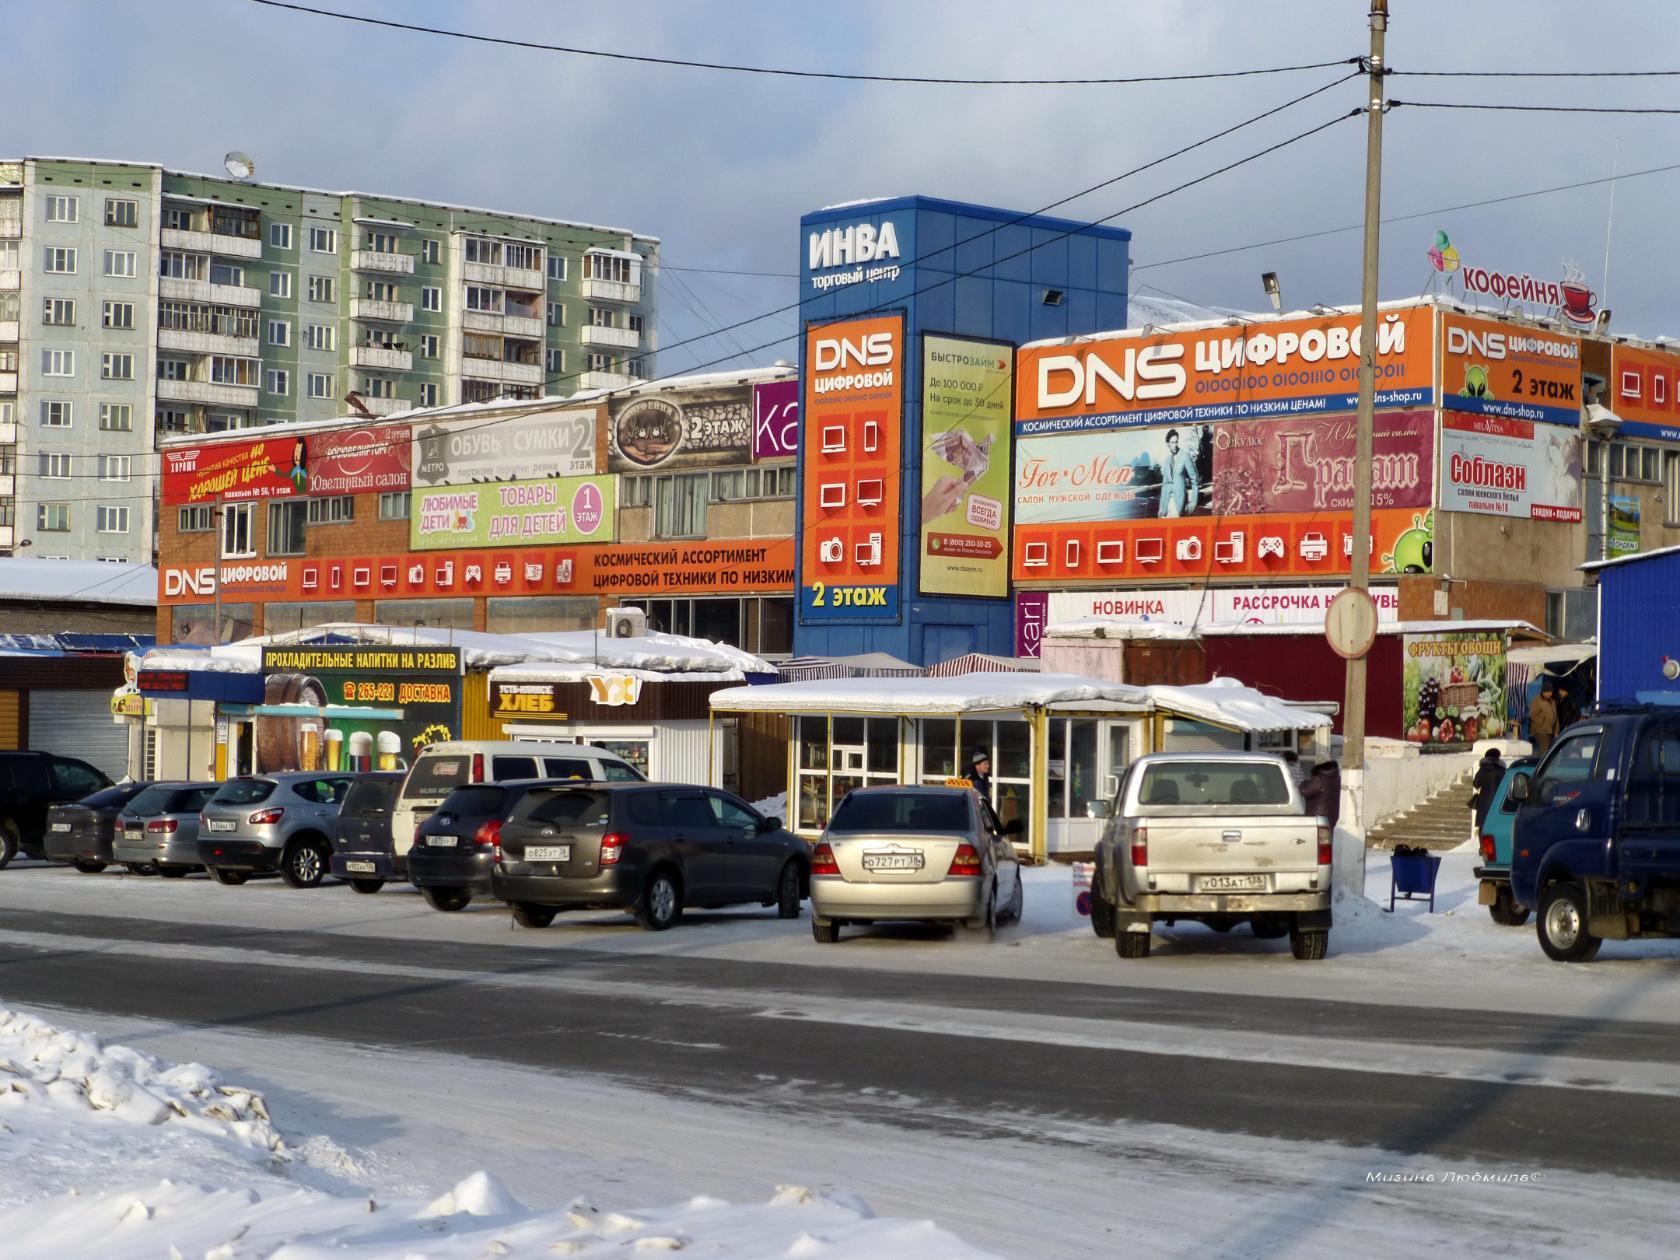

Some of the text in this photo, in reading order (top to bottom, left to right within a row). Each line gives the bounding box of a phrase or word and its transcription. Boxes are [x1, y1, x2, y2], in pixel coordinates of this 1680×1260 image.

[809, 221, 900, 270] ИНВА
[811, 265, 900, 290] торговый центр
[815, 332, 894, 371] DNS
[1448, 326, 1507, 360] DNS
[1508, 335, 1579, 359] ЦИФРОВОЙ
[931, 351, 995, 369] БЫСТРОЗАЙМ
[814, 368, 893, 394] ЦИФРОВОЙ
[930, 377, 941, 388] До
[943, 379, 958, 389] 100
[960, 380, 977, 392] 000
[1037, 343, 1187, 410] DNS
[1511, 368, 1575, 401] 2 этаж
[930, 393, 941, 402] На
[943, 395, 961, 406] срок
[963, 398, 973, 407] до
[1023, 417, 1084, 433] КОСМИЧЕСКИЙ
[1084, 413, 1143, 427] АССОРТИМЕНТ
[1144, 407, 1194, 423] ЦИФРОВОЙ
[1194, 404, 1233, 418] ТЕХНИКИ
[1234, 403, 1249, 415] ПО
[1250, 400, 1290, 414] НИЗКИМ
[1290, 398, 1326, 413] ЦЕНАМ!
[1482, 403, 1544, 419] www.dns-shop.ru
[385, 428, 391, 439] 2
[571, 416, 593, 459] 2
[691, 416, 745, 440] 2 ЭТАЖ
[451, 426, 570, 456] ОБУВЬ СУМКИ
[171, 460, 196, 473] ХОРОШО
[421, 462, 445, 473] МЕТРО
[570, 459, 593, 471] этаж
[1273, 431, 1420, 508] Граат
[1450, 452, 1526, 491] Соблазн
[188, 456, 270, 502] ХОРОШЕЙ ЦЕНЕ
[310, 471, 408, 493] Ювелирный салон
[224, 490, 252, 498] павильон
[271, 486, 275, 495] 1
[276, 486, 291, 495] этаж
[499, 485, 557, 506] ТОВАРЫ
[583, 487, 592, 509] 1
[1017, 490, 1137, 504] САЛОН МУЖСКОЙ ОДЕЖДЫ
[1457, 488, 1520, 502] салон женского белья
[421, 494, 478, 513] ЛЮБИМЫЕ
[971, 504, 997, 519] ВСЕГДА
[1532, 507, 1553, 518] СКИДКИ
[420, 514, 450, 532] ДЕТИ
[489, 508, 567, 538] ДЛЯ ДЕТЕЙ
[576, 511, 598, 523] ЭТАЖ
[594, 548, 767, 567] КОСМИЧЕСКИЙ АССОРТИМЕНТ
[165, 567, 216, 596] DNS
[220, 561, 288, 584] ЦИФРОВОЙ
[593, 569, 795, 590] ЦИФРОВОЙ ТЕХНИКИ ПО НИЗКИМ
[811, 581, 887, 607] 2 этаж
[1232, 594, 1321, 611] РАССРОЧКА
[1093, 600, 1165, 616] НОВИНКА
[1019, 602, 1041, 659] kari
[1408, 640, 1501, 657] ФРУКТЫ ОВОЩИ
[265, 652, 457, 670] ПРОХЛАДИТЕЛЬНЫЕ НАПИТКИ НА РАЗЛИВ
[358, 683, 451, 704] 265-221 ДОСТАВКА
[499, 693, 555, 713] ХЛЕБ
[867, 857, 907, 868] О727РТ
[1203, 877, 1246, 889] У013АТ
